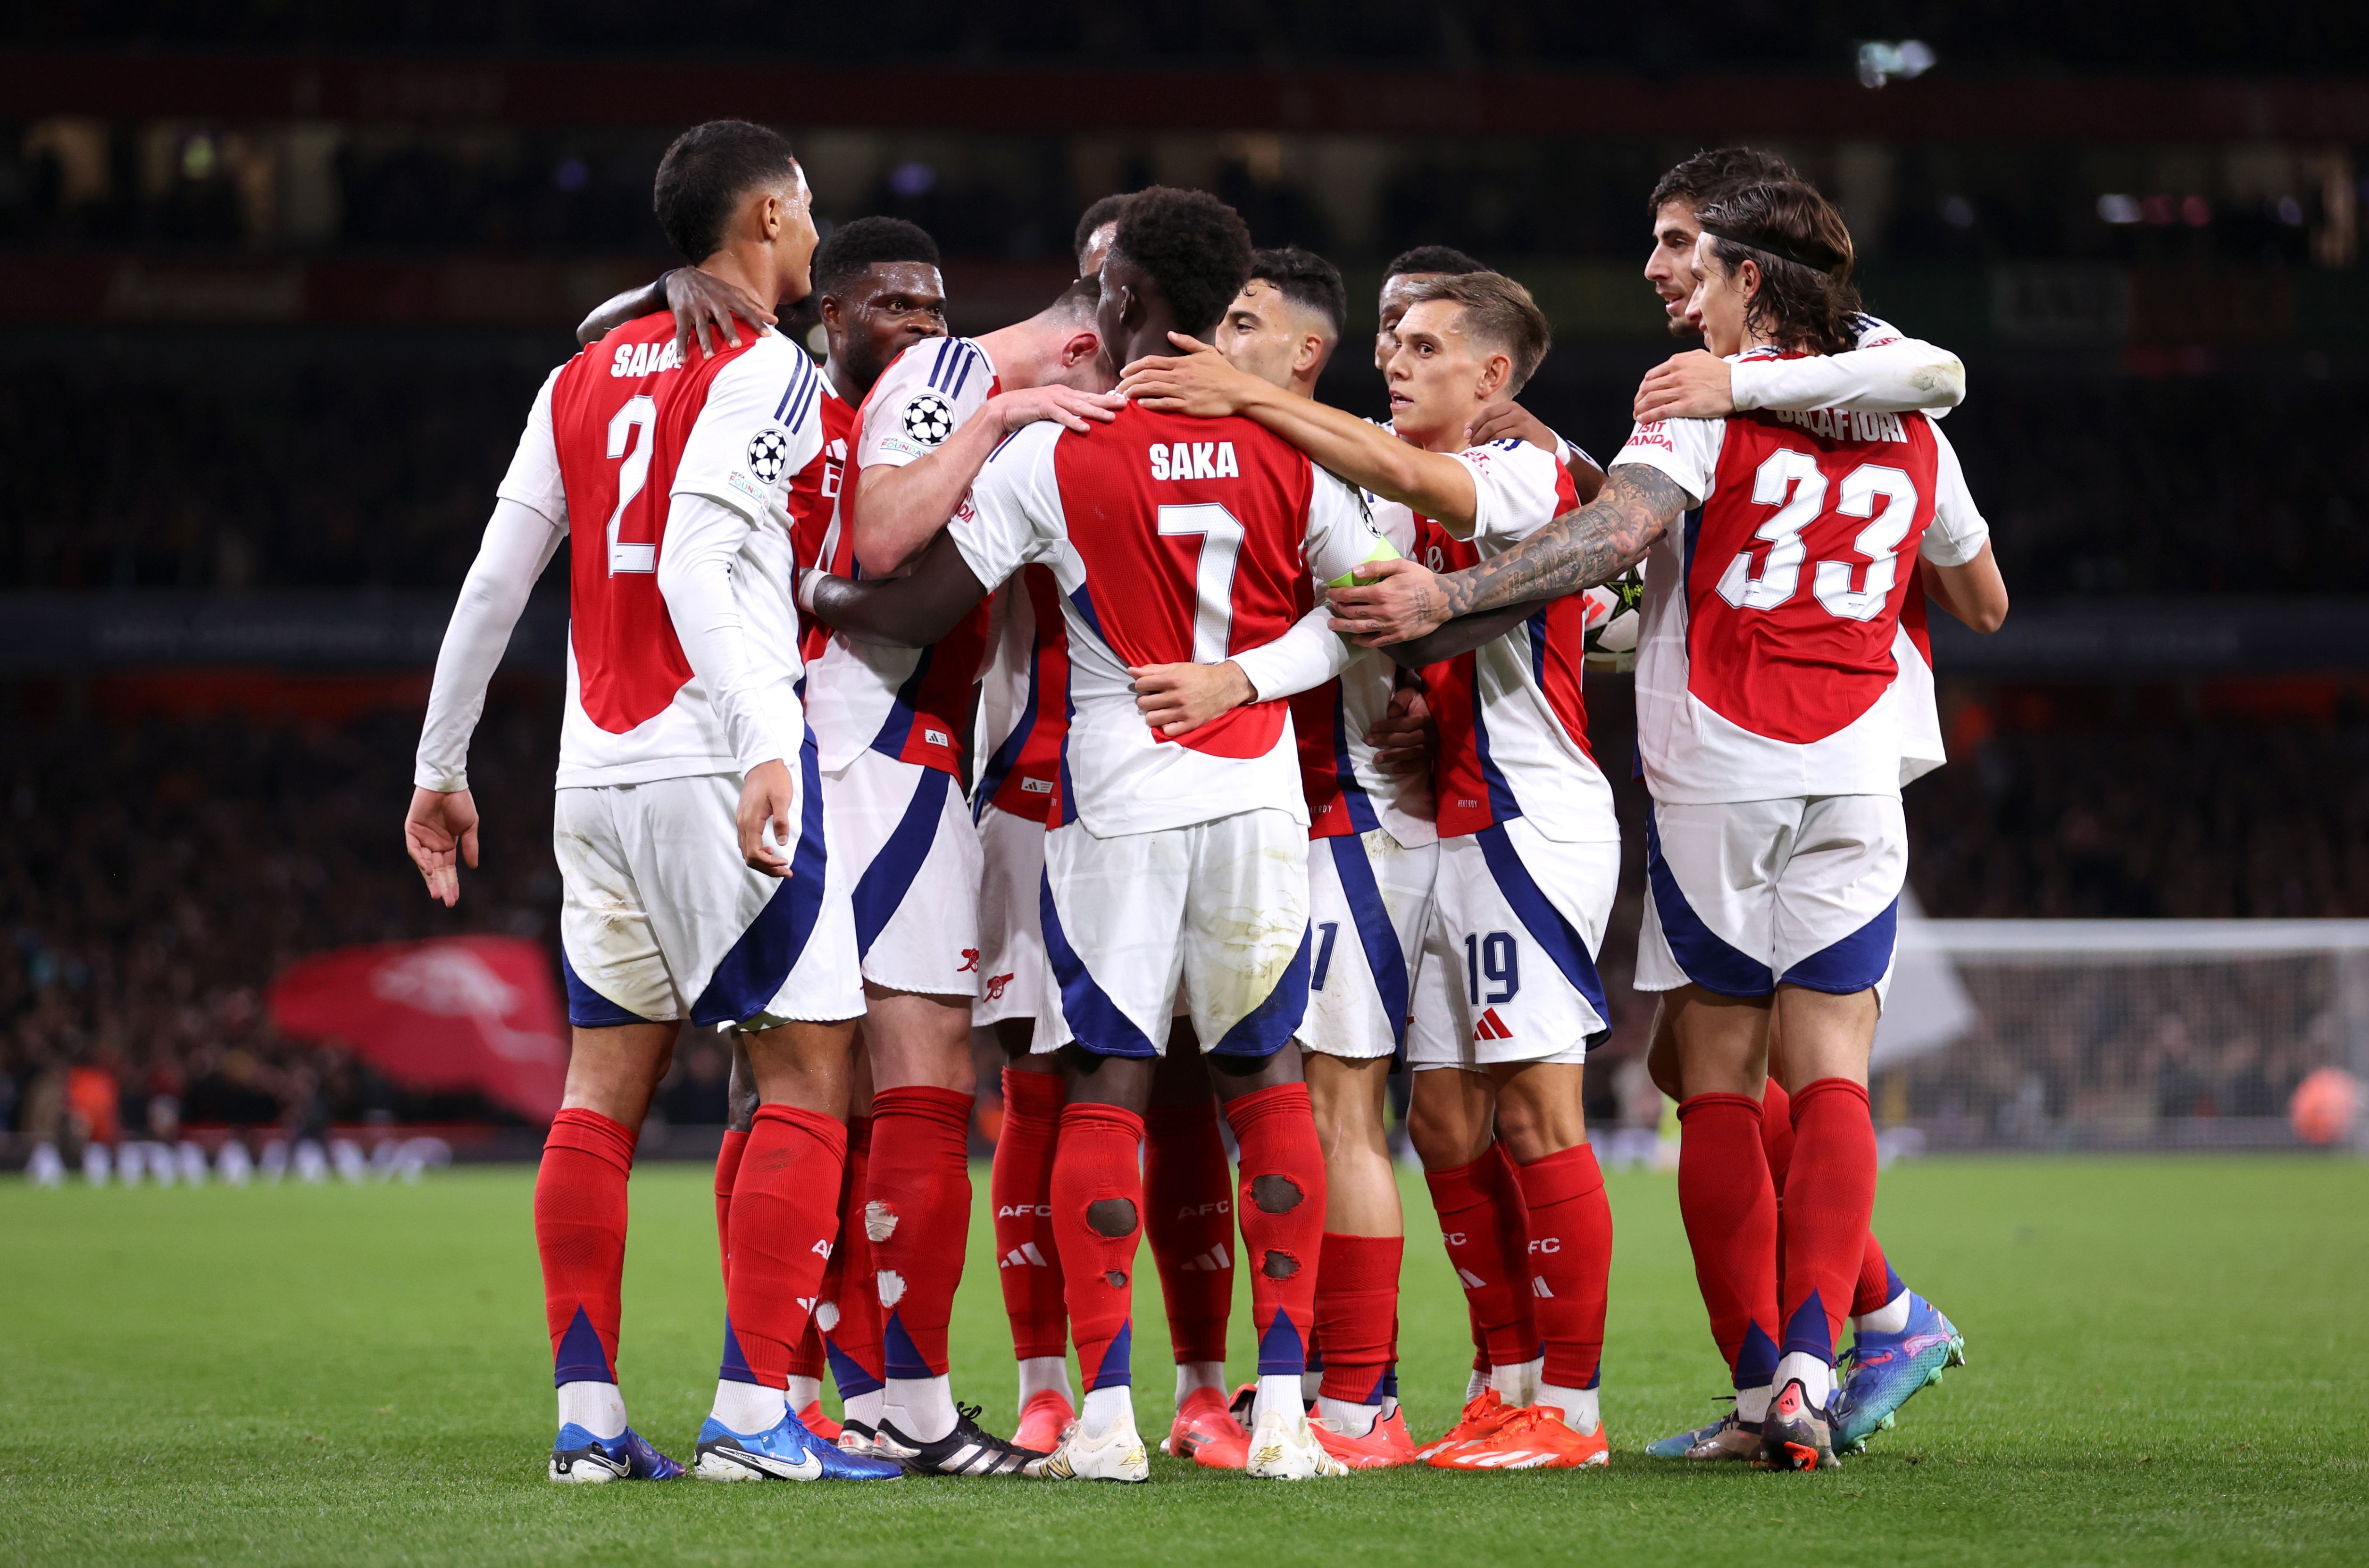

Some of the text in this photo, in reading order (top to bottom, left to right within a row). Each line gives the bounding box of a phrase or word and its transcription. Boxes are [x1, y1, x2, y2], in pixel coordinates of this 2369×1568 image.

[607, 394, 658, 578] 2
[1149, 442, 1239, 481] SAKA
[1715, 448, 1919, 623] 33
[1157, 502, 1245, 664] 7
[1310, 920, 1341, 993] 1
[1464, 930, 1521, 1007] 19
[999, 1204, 1051, 1218] AFC
[1178, 1200, 1229, 1219] AFC
